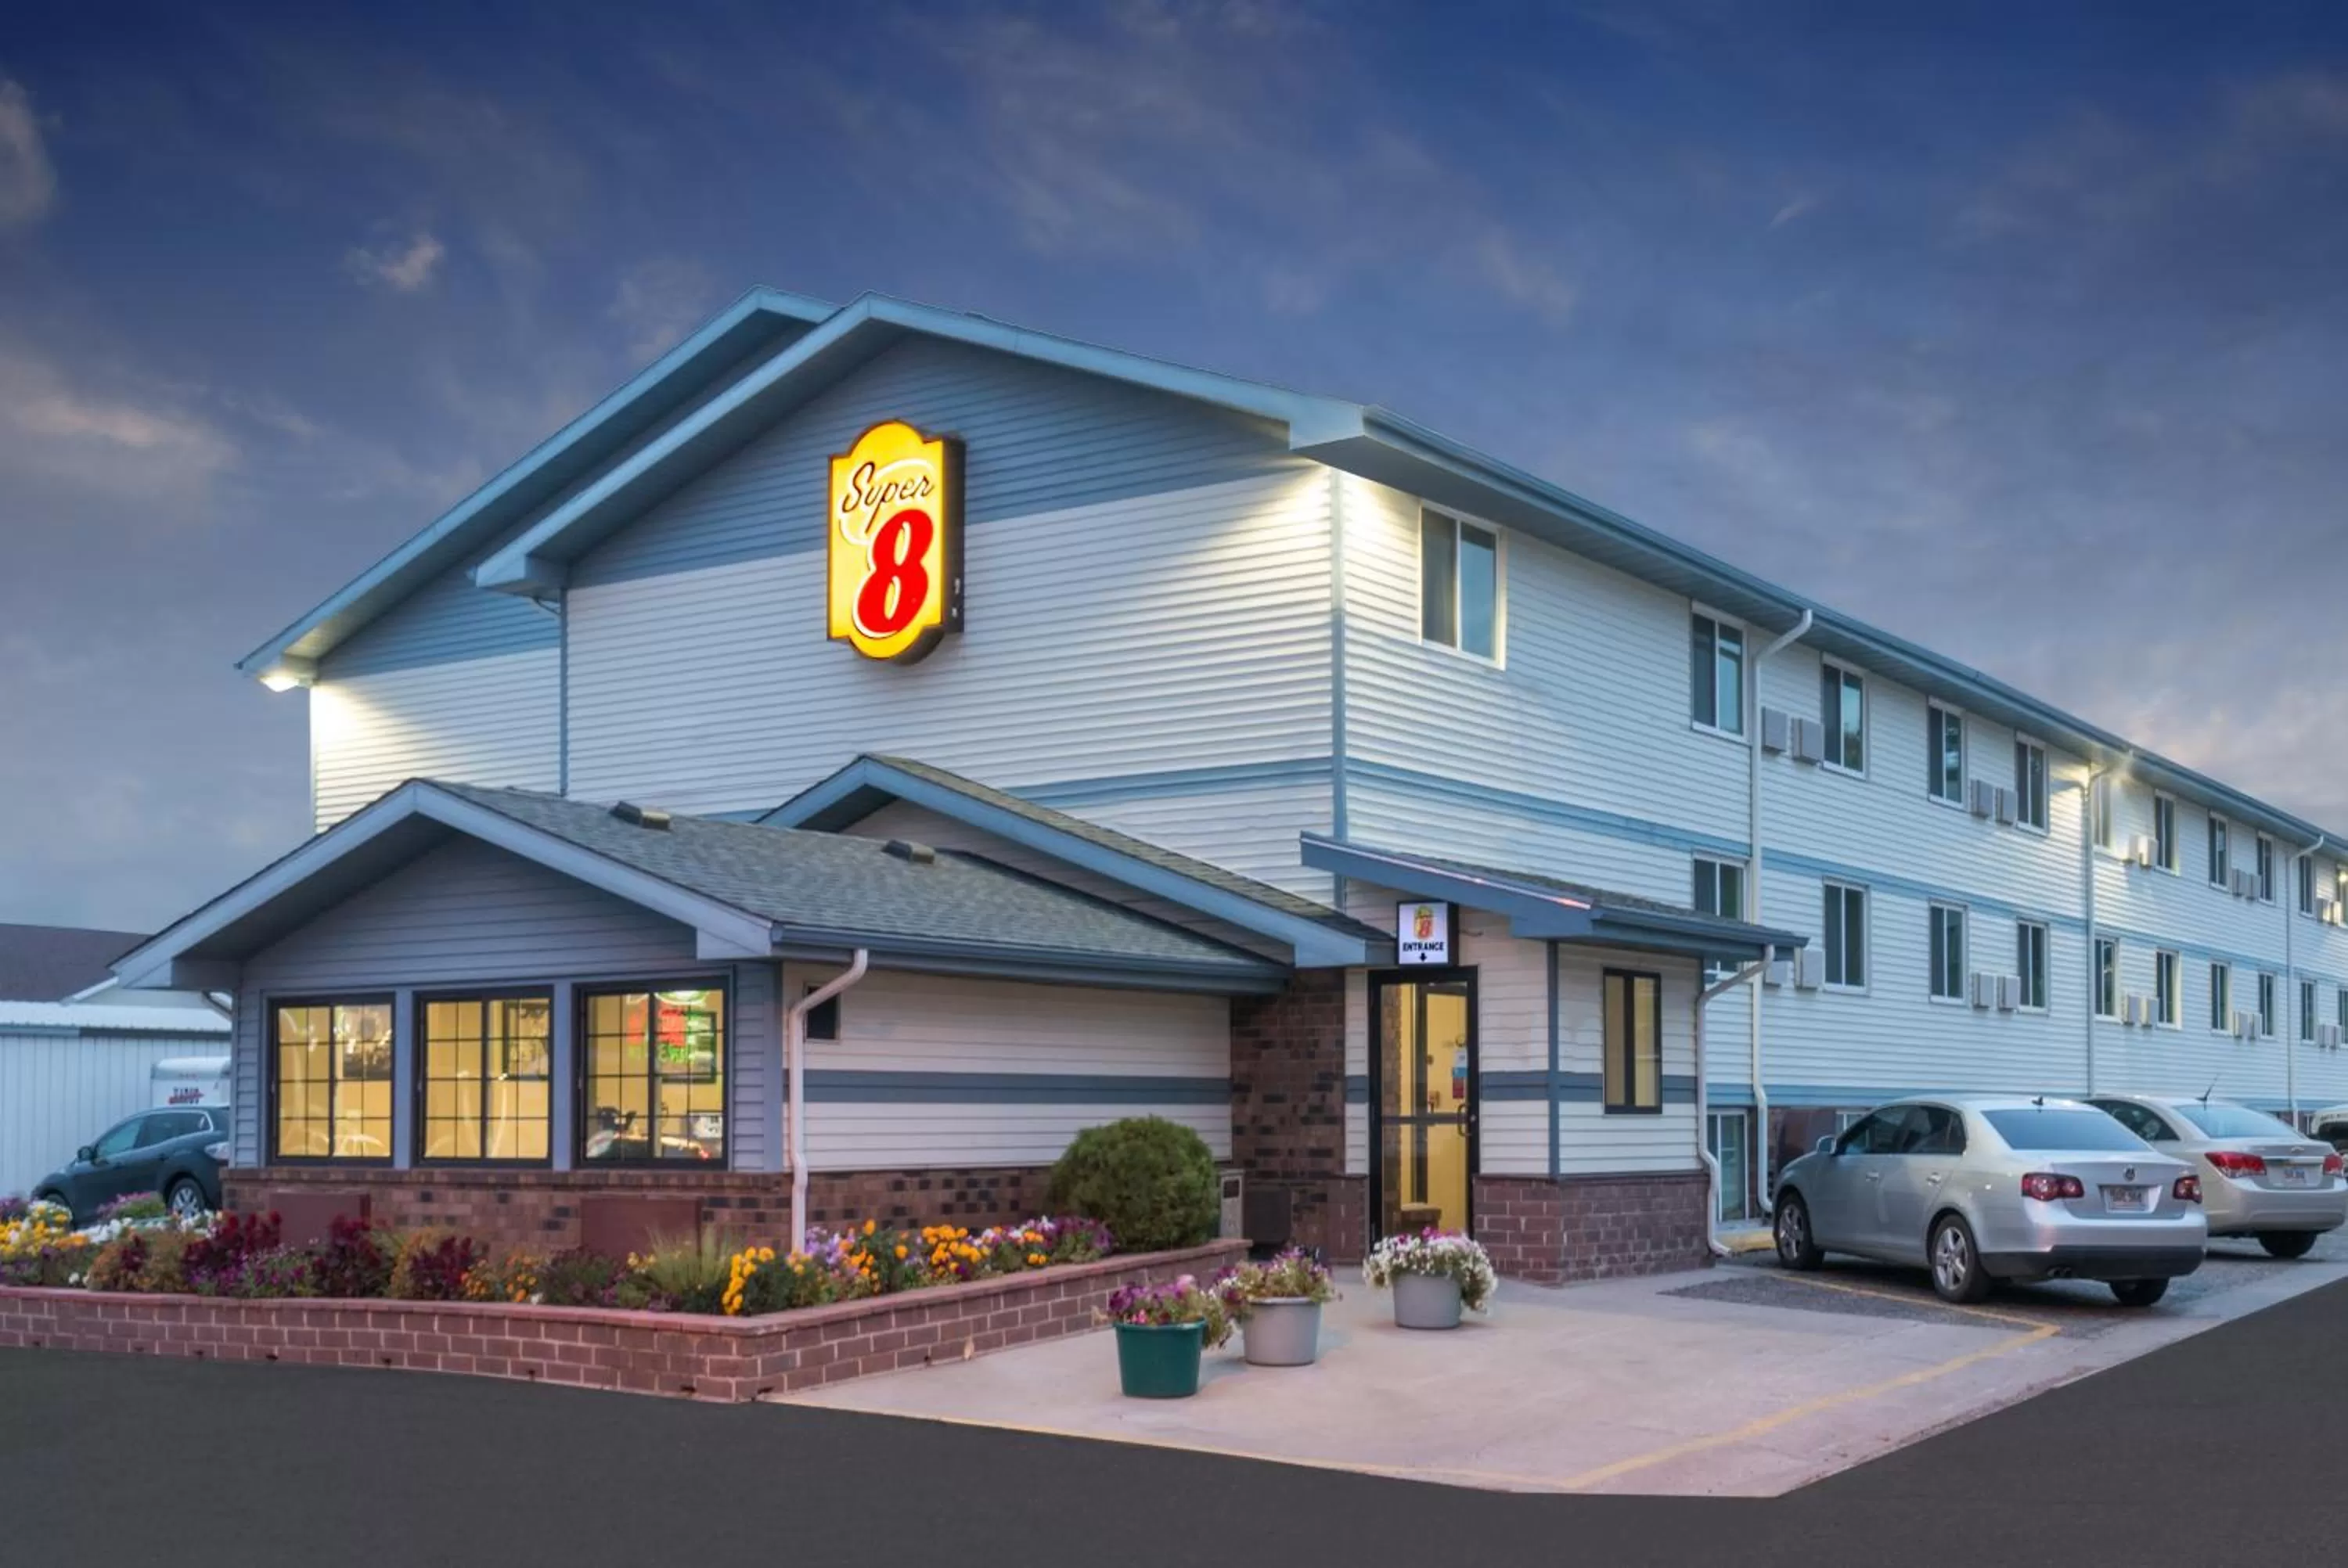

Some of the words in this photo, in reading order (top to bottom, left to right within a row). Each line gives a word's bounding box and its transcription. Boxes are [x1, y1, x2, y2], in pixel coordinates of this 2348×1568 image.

[841, 460, 935, 534] Super
[855, 509, 935, 635] 8
[1403, 941, 1445, 952] ENTRANCE
